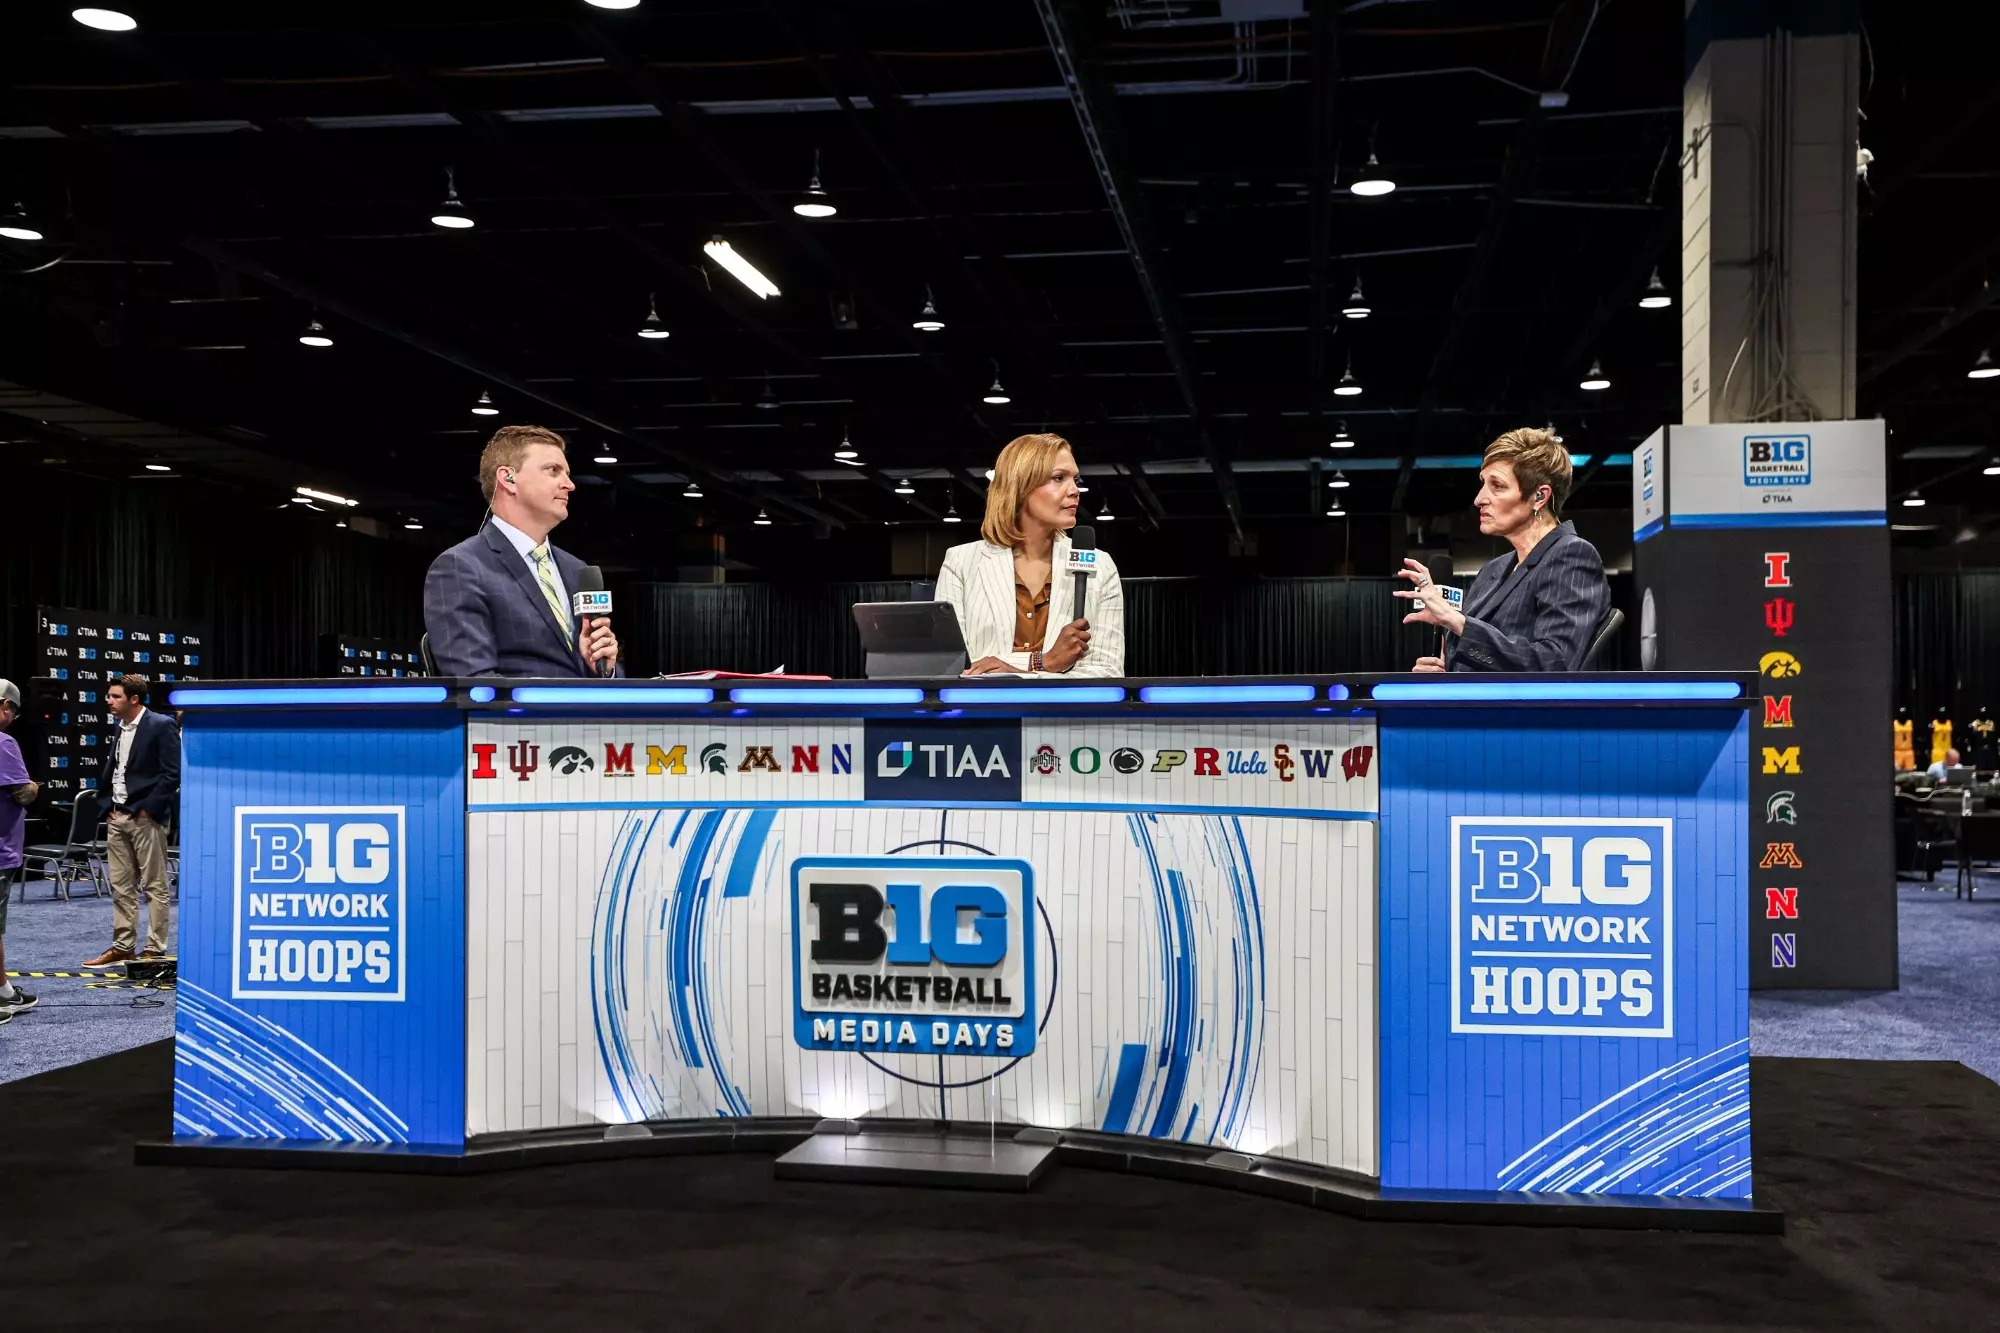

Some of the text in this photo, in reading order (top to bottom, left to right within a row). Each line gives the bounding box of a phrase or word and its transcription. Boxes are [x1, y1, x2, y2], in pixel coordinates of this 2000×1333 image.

[1750, 465, 1804, 473] BASKETBALL
[1772, 495, 1793, 503] TIAA
[42, 617, 48, 628] 3
[1764, 696, 1792, 725] M
[604, 743, 635, 773] M
[646, 745, 687, 775] M
[738, 746, 781, 772] M
[792, 745, 819, 773] N
[832, 744, 852, 774] N
[919, 745, 1011, 778] TIAA
[1151, 750, 1187, 773] P
[1194, 748, 1221, 775] R
[1301, 750, 1333, 778] W
[1341, 746, 1373, 783] W
[1762, 747, 1800, 774] M
[1760, 843, 1802, 868] M
[249, 893, 389, 918] NETWORK
[1766, 888, 1798, 918] N
[1471, 915, 1651, 943] NETWORK
[248, 939, 390, 983] HOOPS
[1772, 933, 1796, 967] N
[812, 973, 1011, 1005] BASKETBALL
[1470, 967, 1653, 1017] HOOPS
[813, 1019, 1014, 1047] MEDIA DAYS
